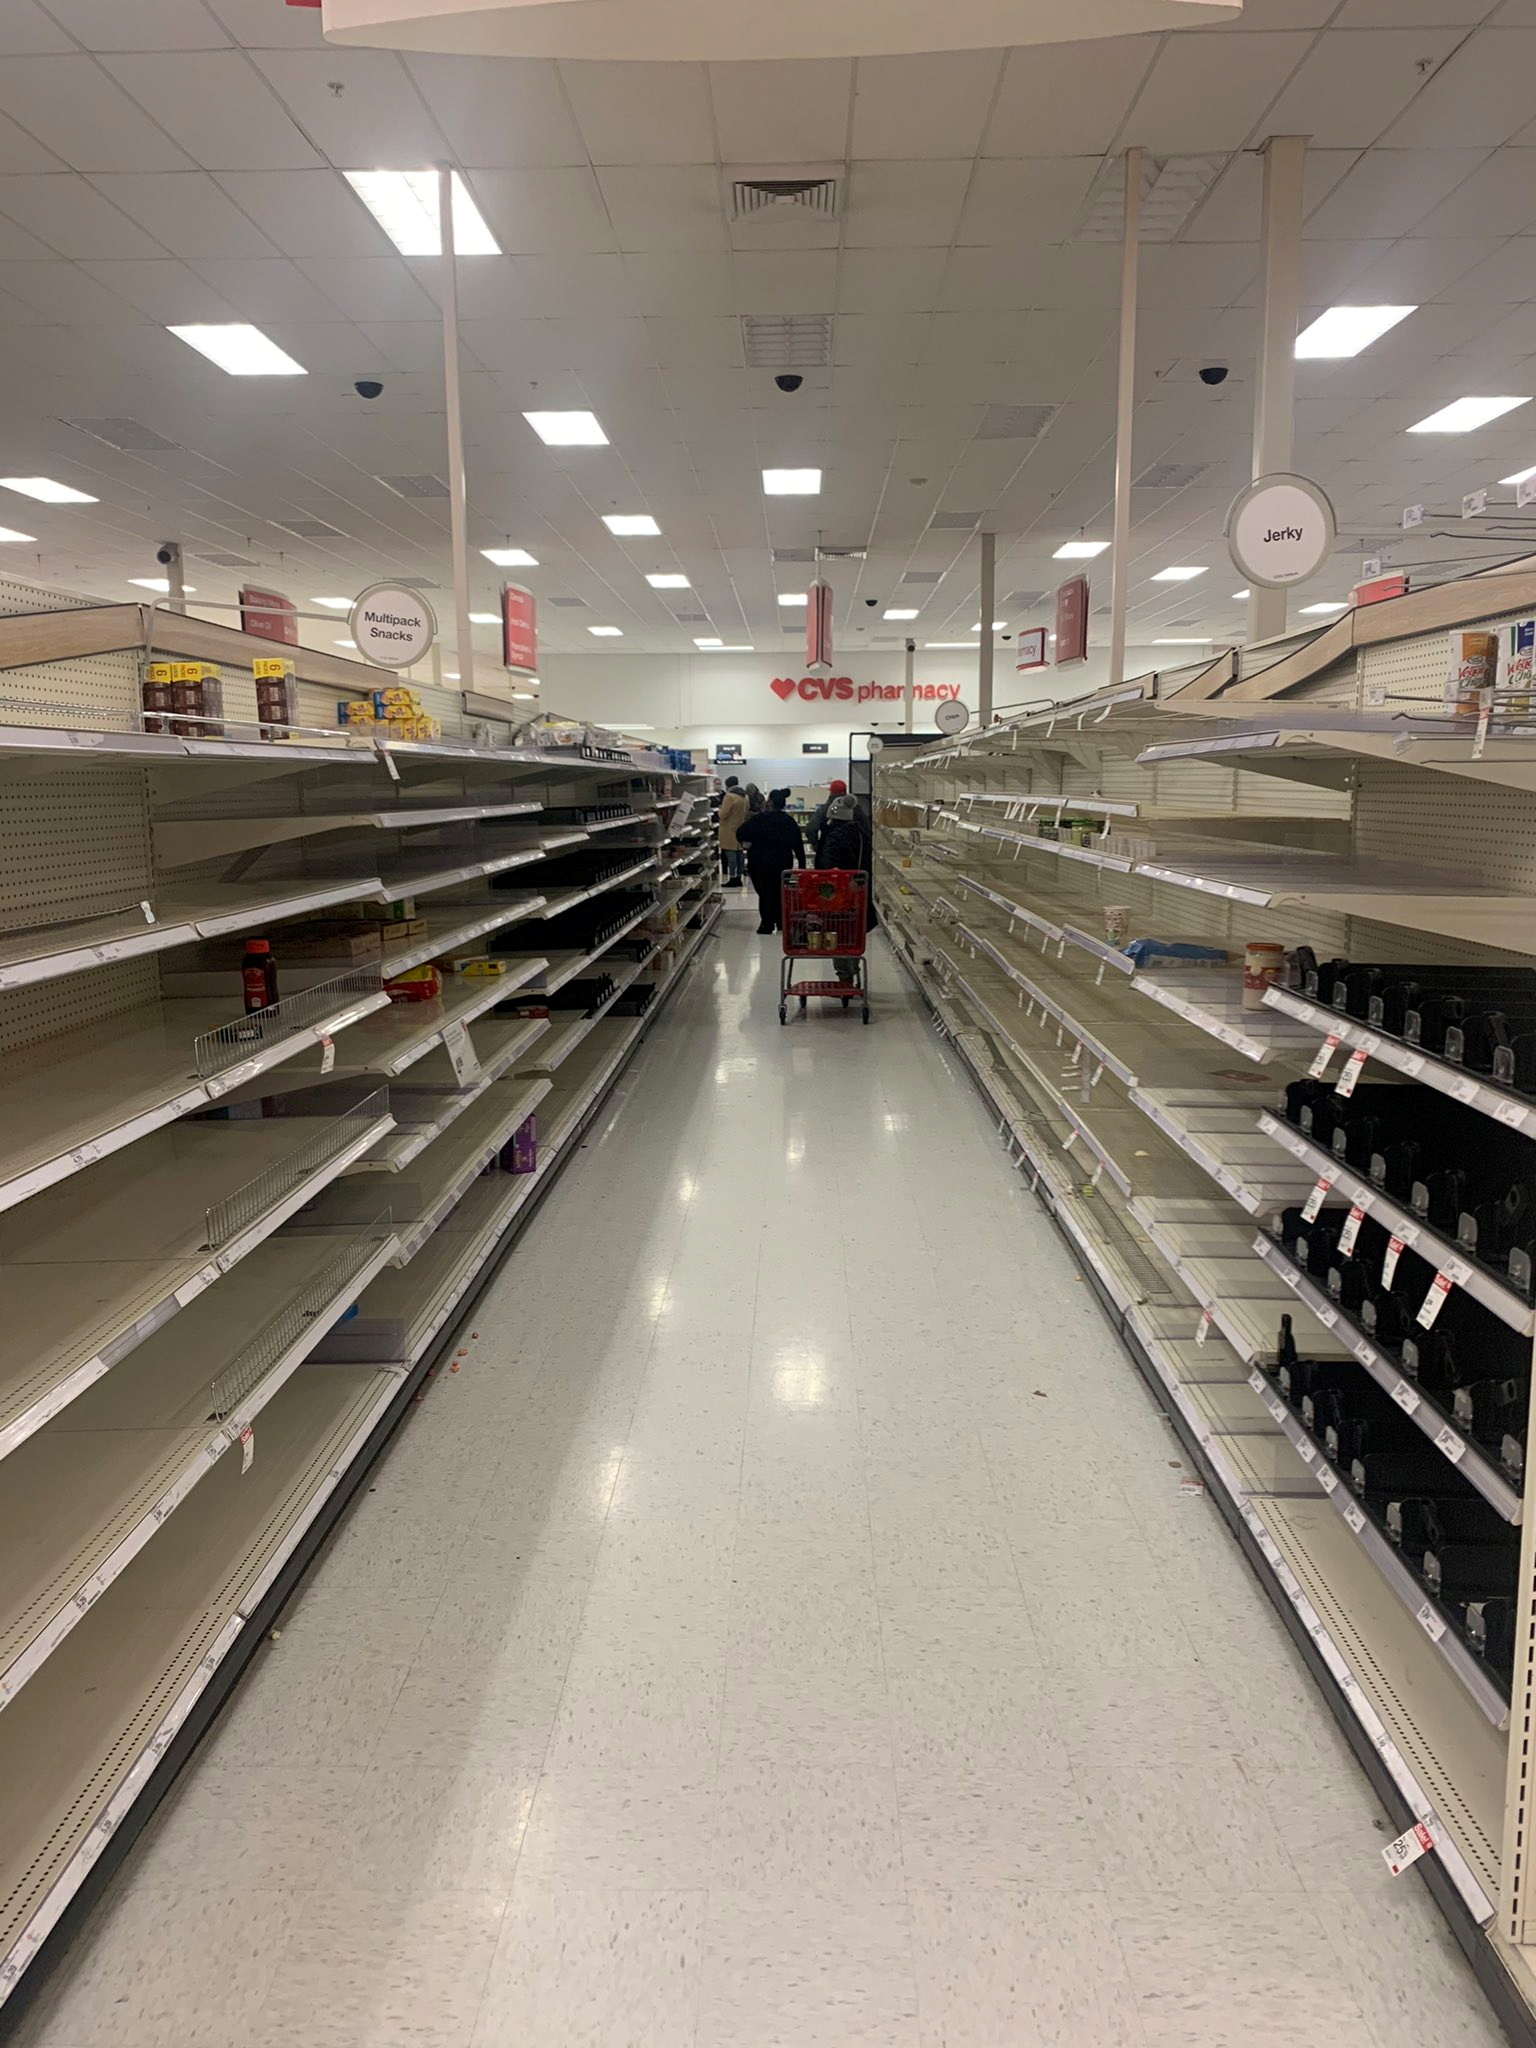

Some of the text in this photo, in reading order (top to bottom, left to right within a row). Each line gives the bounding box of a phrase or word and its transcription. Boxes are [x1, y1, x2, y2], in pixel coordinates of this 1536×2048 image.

[1264, 526, 1303, 542] Jerky
[364, 611, 422, 628] Multipack
[370, 627, 414, 642] Snacks
[798, 677, 854, 701] CVS
